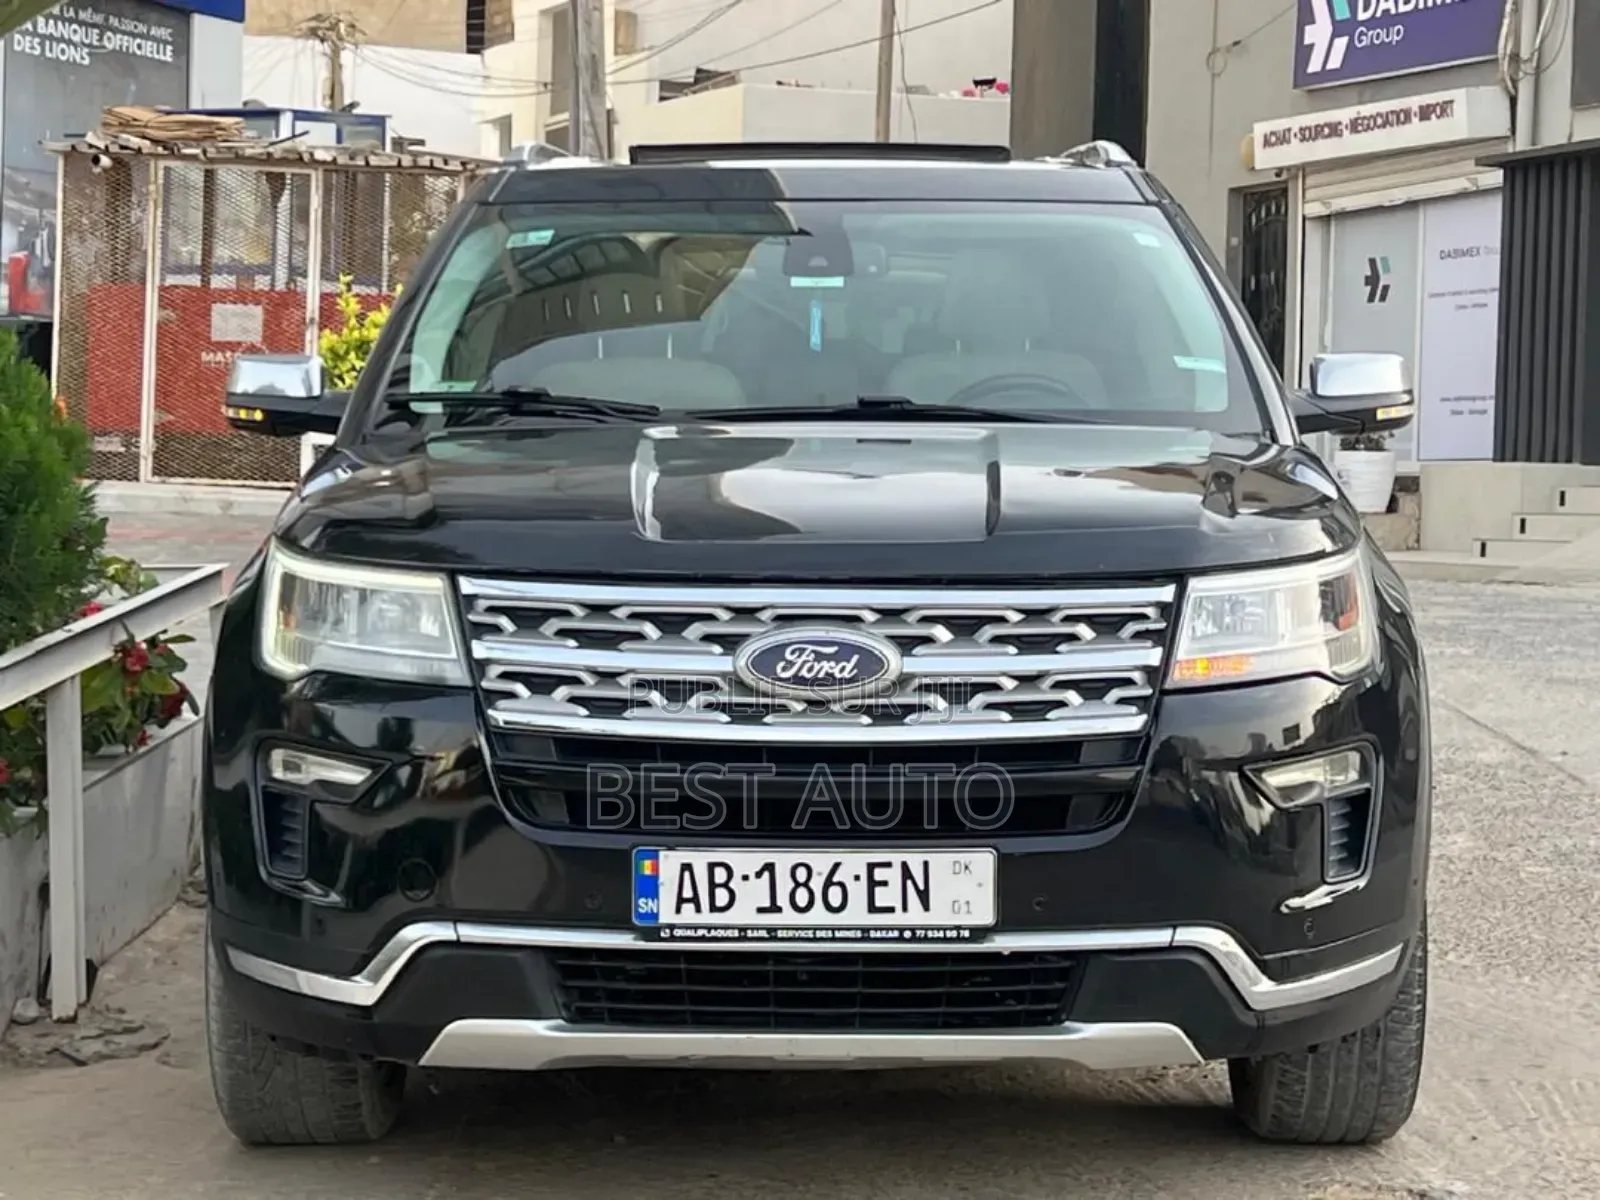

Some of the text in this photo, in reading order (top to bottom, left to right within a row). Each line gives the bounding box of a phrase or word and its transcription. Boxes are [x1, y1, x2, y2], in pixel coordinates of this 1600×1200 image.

[36, 15, 101, 46] BANQUE
[103, 32, 174, 62] OFFICIELLE
[63, 5, 76, 19] LA
[108, 15, 148, 34] PASSION
[150, 25, 174, 42] AVEC
[1354, 24, 1404, 48] Group
[13, 33, 91, 66] DES LIONS
[1263, 99, 1455, 149] ACHAT SOURCING NÉGOCIATION IMPORT
[776, 643, 860, 679] Ford
[951, 861, 974, 876] DK
[637, 897, 658, 914] SN
[951, 899, 974, 916] 01
